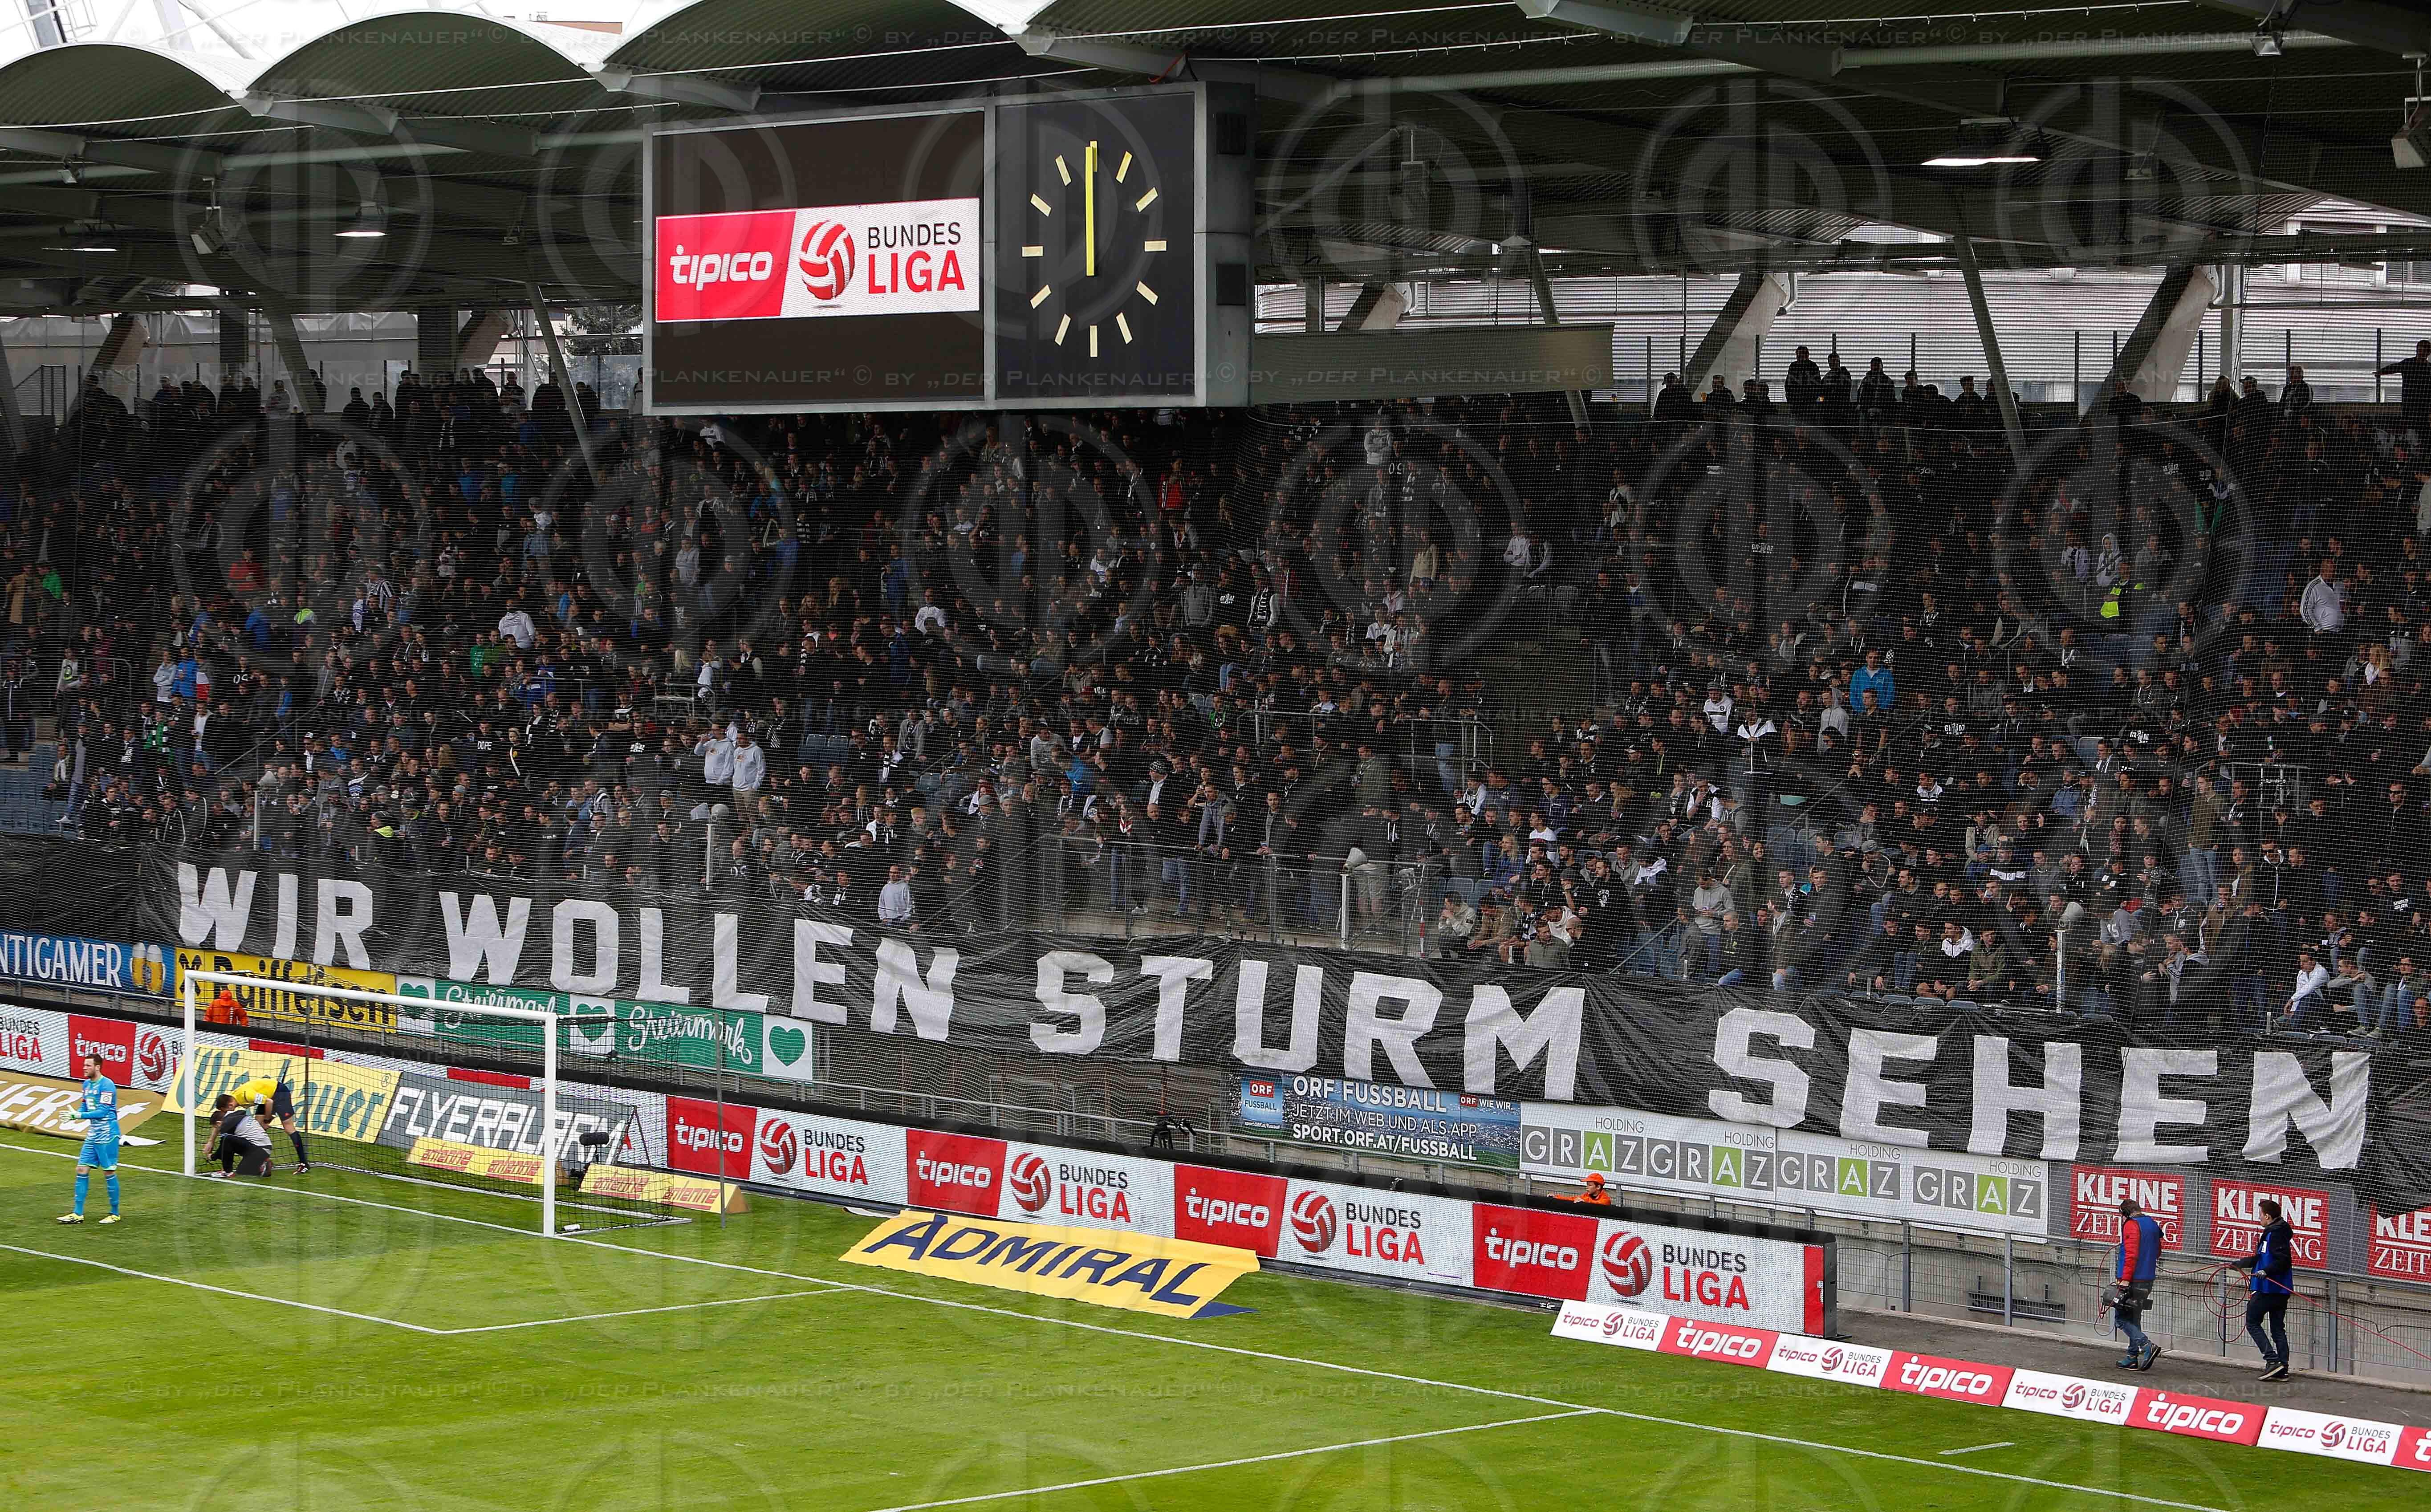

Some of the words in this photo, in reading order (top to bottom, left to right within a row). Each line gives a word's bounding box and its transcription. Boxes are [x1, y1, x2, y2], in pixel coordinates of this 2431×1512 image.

[867, 222, 961, 249] BUNDES
[670, 244, 773, 291] tipico
[867, 249, 965, 294] LIGA
[477, 741, 493, 750] DOPE
[179, 862, 374, 971] WIR
[439, 892, 959, 1041] WOLLEN
[1030, 950, 1585, 1101] STURM
[1708, 1008, 2370, 1169] SEHEN
[0, 1033, 42, 1062] LIGA
[1252, 1084, 1272, 1094] ORF
[1293, 1076, 1335, 1098] ORF
[1343, 1081, 1447, 1113] FUSSBALL
[1460, 1097, 1476, 1105] ORF
[1479, 1099, 1494, 1108] WIE
[1244, 1100, 1276, 1110] FUSSBALL
[1293, 1103, 1331, 1119] JETZT
[1336, 1108, 1350, 1123] IM
[1354, 1110, 1384, 1126] WEB
[1388, 1115, 1417, 1131] UND
[1421, 1120, 1446, 1134] ALS
[1451, 1123, 1477, 1138] APP
[1596, 1117, 1644, 1133] HOLDING
[805, 1130, 865, 1152] BUNDES
[1293, 1123, 1477, 1160] SPORT.ORF.AT/FUSSBALL
[1524, 1130, 1638, 1171] GRAZ
[1724, 1131, 1774, 1148] HOLDING
[1850, 1144, 1900, 1159] HOLDING
[805, 1148, 868, 1185] LIGA
[915, 1150, 991, 1188] tipico
[1060, 1164, 1128, 1188] BUNDES
[1650, 1144, 1767, 1187] GRAZ
[1781, 1156, 1893, 1195] GRAZ
[1990, 1161, 2041, 1177] HOLDING
[1060, 1184, 1131, 1223] LIGA
[1917, 1172, 2035, 1215] GRAZ
[2077, 1173, 2177, 1212] KLEINE
[1185, 1187, 1270, 1227] tipico
[1346, 1203, 1421, 1229] BUNDES
[2218, 1188, 2321, 1229] KLENE
[1346, 1223, 1425, 1264] LIGA
[1484, 1227, 1579, 1271] tipico
[862, 1214, 1211, 1306] ADMIRAL
[1663, 1244, 1747, 1272] BUNDES
[1663, 1267, 1750, 1310] LIGA
[1564, 1312, 1599, 1329] tipico
[1622, 1325, 1655, 1341] LIGA
[1628, 1317, 1659, 1328] BUNDES
[1676, 1320, 1762, 1358] tipico
[1779, 1345, 1817, 1363] tipico
[1848, 1352, 1882, 1364] BUNDES
[1842, 1360, 1878, 1378] LIGA
[1900, 1356, 1993, 1396] tipico
[2016, 1382, 2057, 1399] tipico
[2090, 1388, 2126, 1401] BUNDES
[2086, 1398, 2123, 1414] LIGA
[2146, 1393, 2244, 1435] tipico
[2270, 1421, 2315, 1439] tipico
[2350, 1427, 2391, 1439] BUNDES
[2347, 1437, 2386, 1454] LIGA
